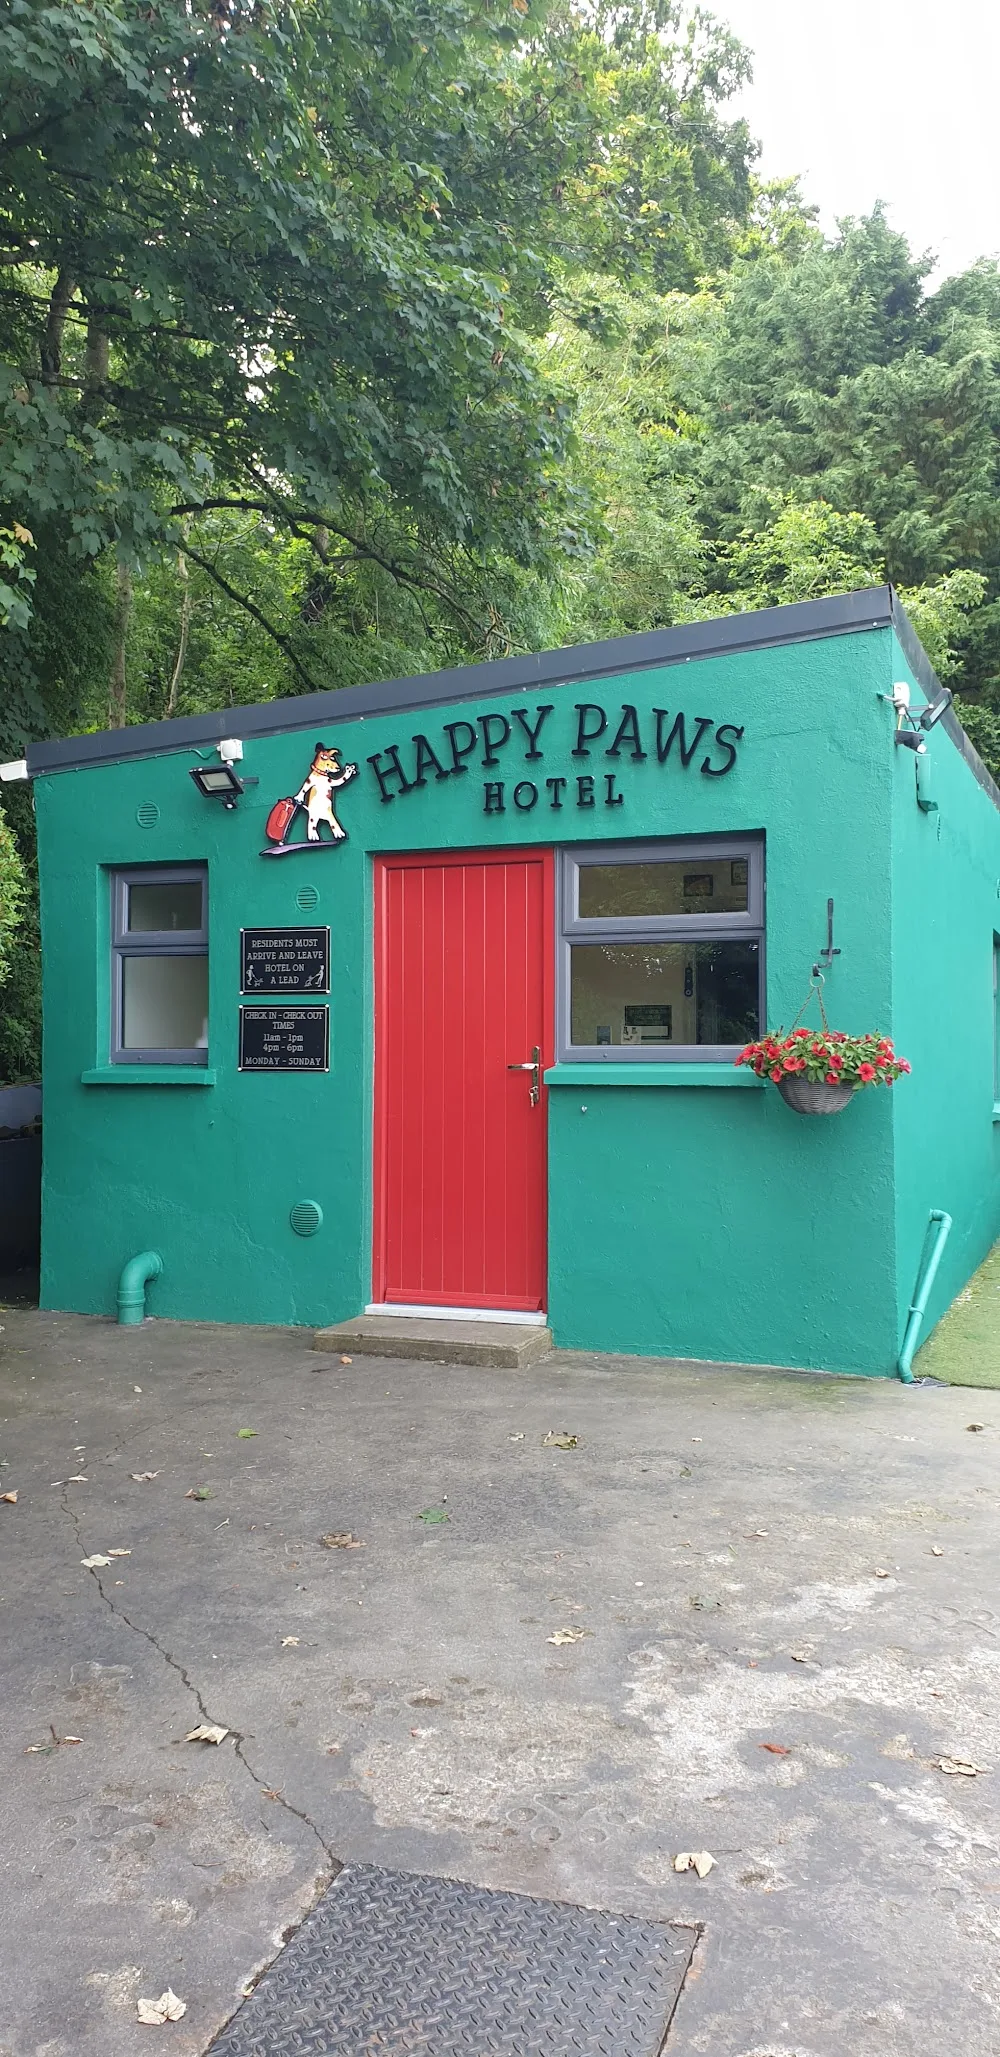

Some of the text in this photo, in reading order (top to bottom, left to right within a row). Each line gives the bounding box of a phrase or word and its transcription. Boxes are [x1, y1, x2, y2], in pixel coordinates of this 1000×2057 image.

[366, 703, 745, 803] HAPPY PAWS
[483, 774, 625, 812] HOTEL
[252, 939, 318, 948] RESIDENTS MUST
[247, 951, 323, 960] ARRIVE AND LEAVE
[288, 1034, 303, 1043] 1pm
[287, 1044, 303, 1053] 6pm
